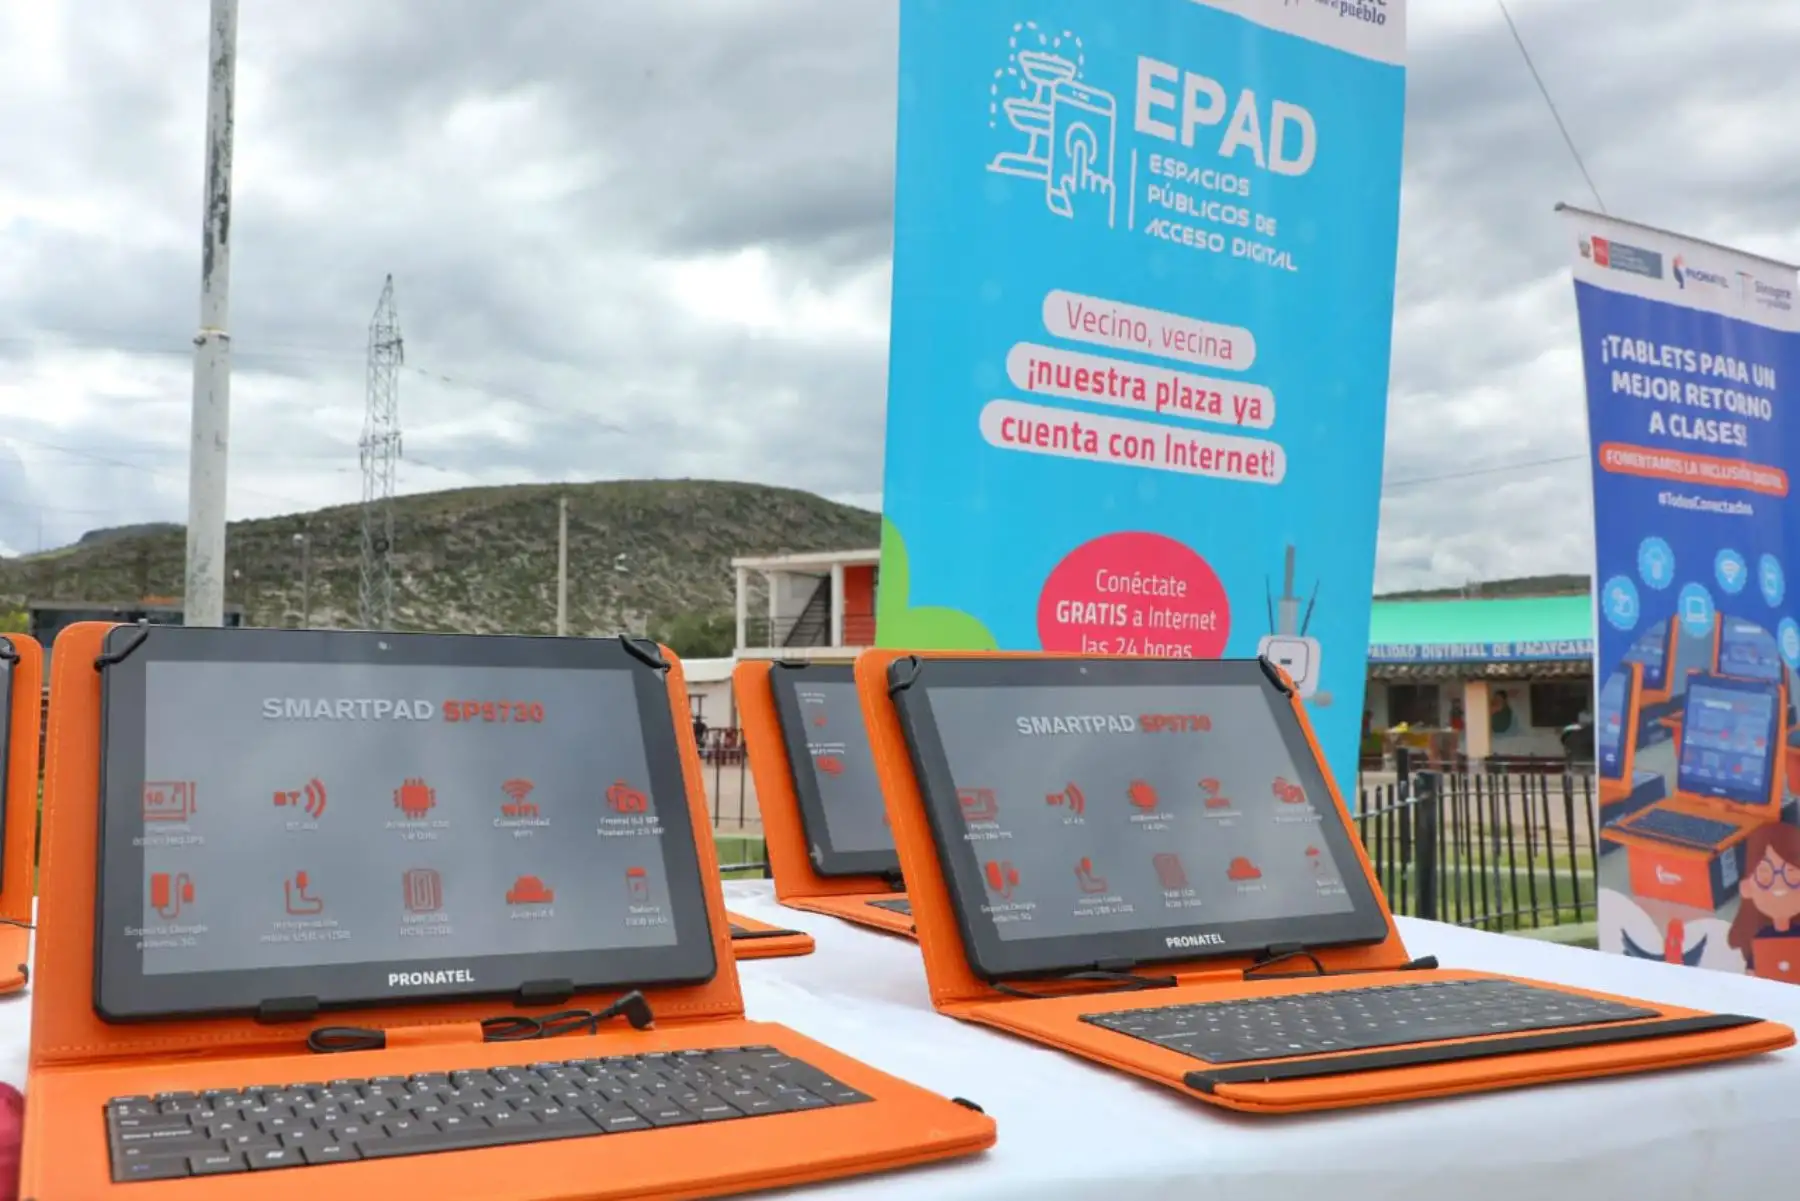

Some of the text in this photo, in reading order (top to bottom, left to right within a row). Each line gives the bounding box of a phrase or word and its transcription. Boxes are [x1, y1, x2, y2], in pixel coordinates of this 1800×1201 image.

[1339, 1, 1387, 26] pueblo
[1134, 55, 1317, 177] EPAD
[1149, 153, 1249, 197] ESPACIOS
[1147, 182, 1277, 237] PÚBLICOS DE
[1144, 217, 1298, 271] ACCESO DIGITAL
[1066, 299, 1233, 360] Vecino, vecina
[1601, 335, 1777, 390] ¡TABLETS PARA UN
[1027, 358, 1262, 426] ¡nuestra plaza ya
[1611, 370, 1773, 421] MEJOR RETORNO
[1000, 415, 1276, 478] cuenta con Internet!
[1648, 411, 1747, 447] A CLASES!
[1096, 568, 1188, 598] Conéctate
[1056, 600, 1217, 631] GRATIS a Internet
[1081, 633, 1193, 660] las 24 horas
[262, 697, 435, 721] SMARTPAD
[1016, 714, 1136, 736] SMARTPAD
[1165, 932, 1226, 949] PRONATEL
[388, 968, 475, 987] PRONATEL
